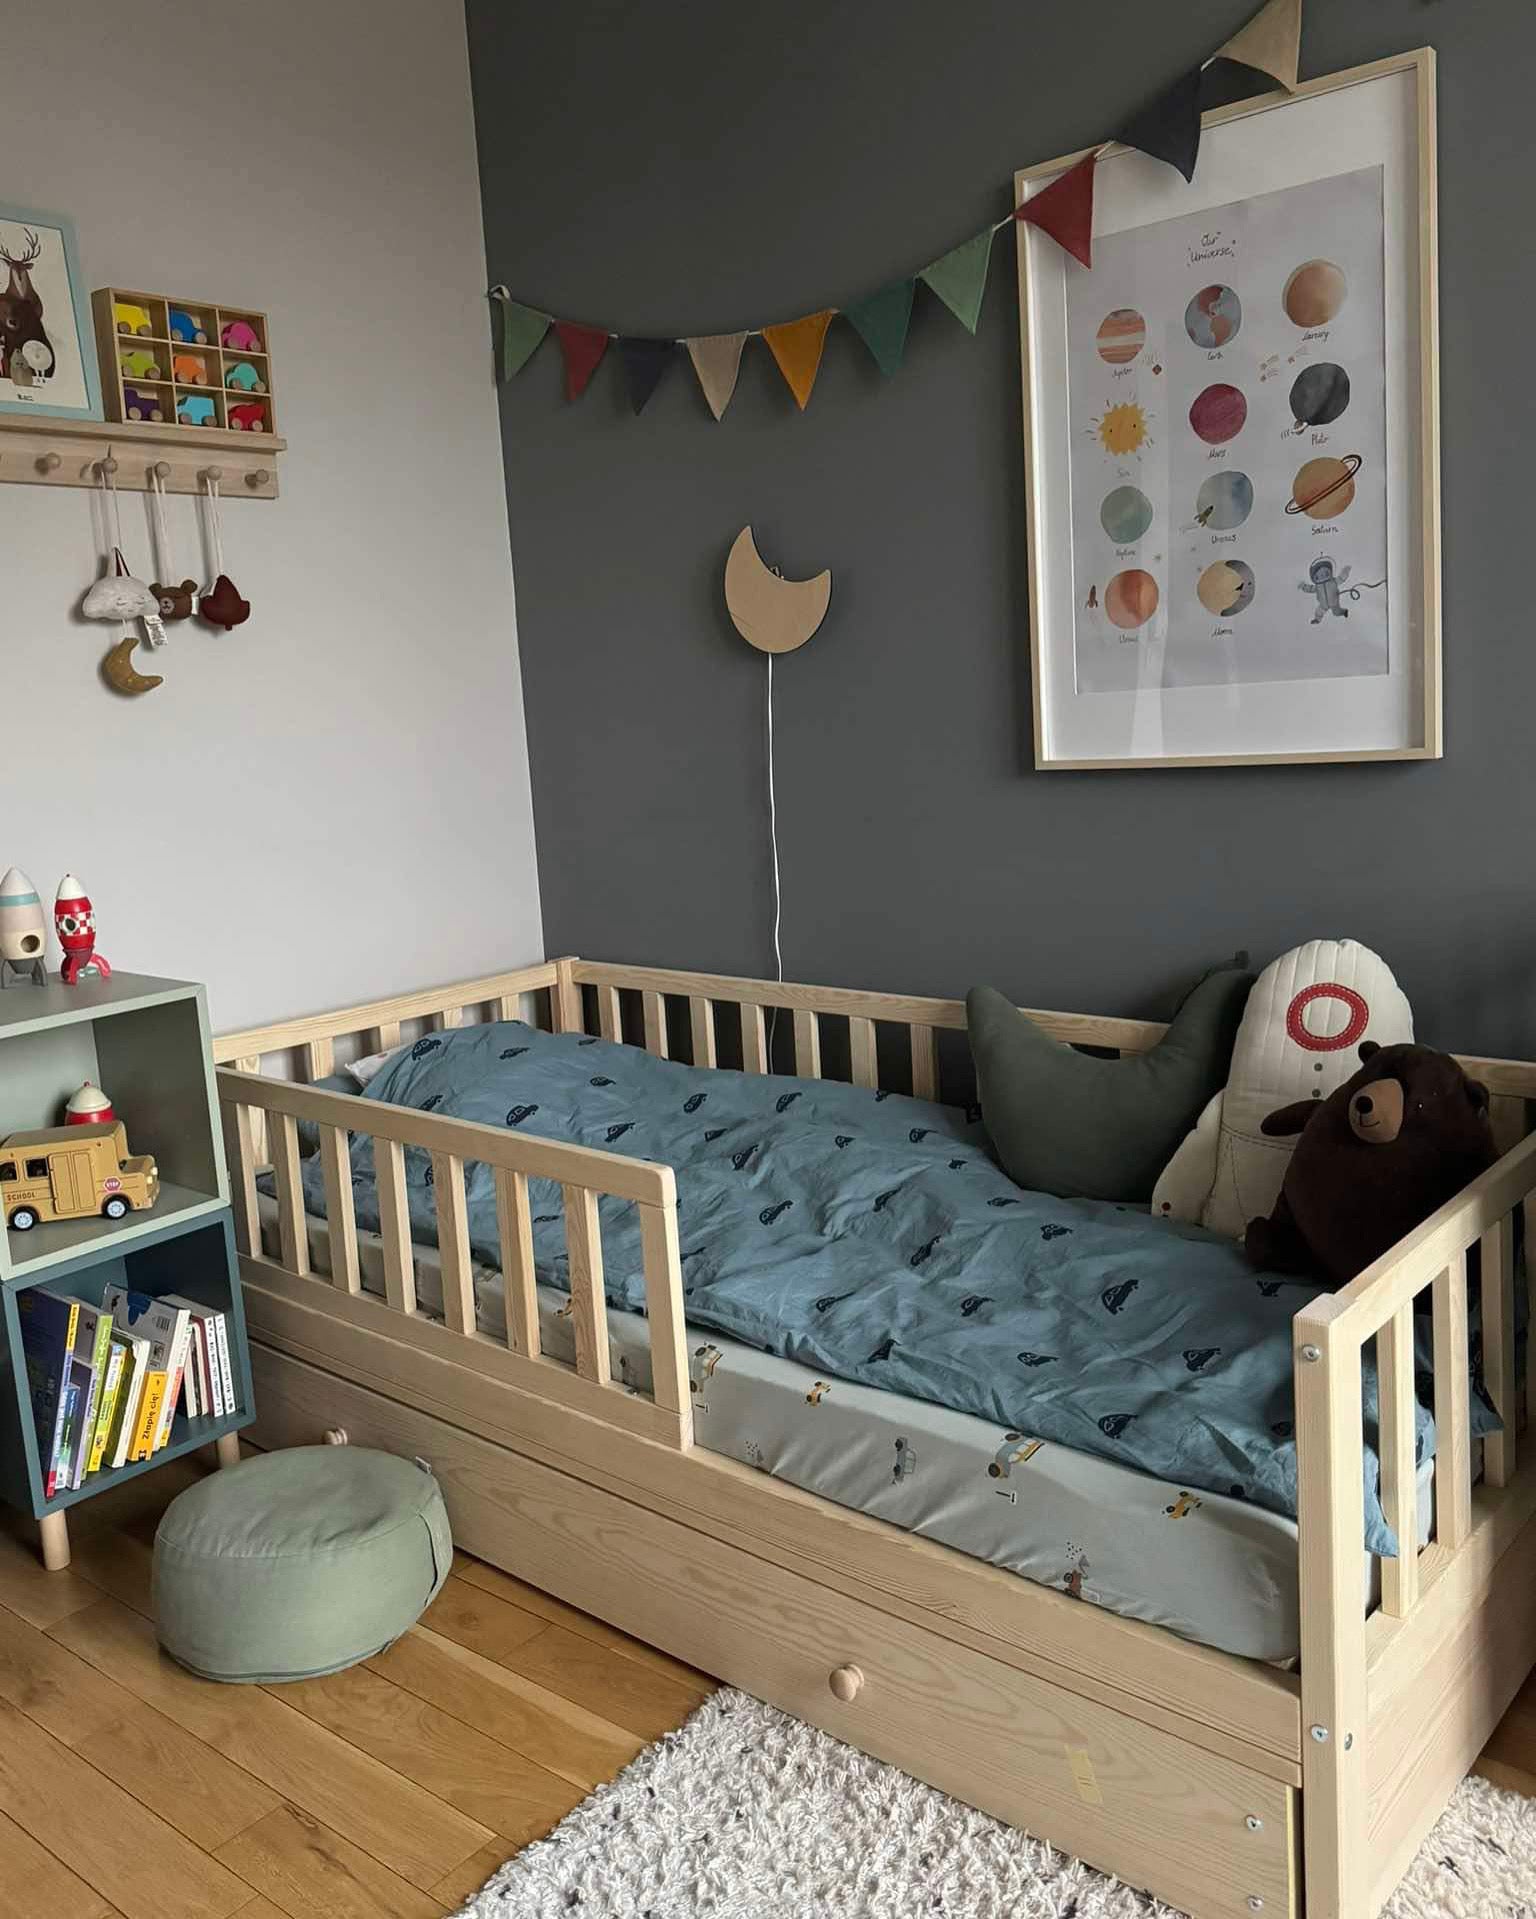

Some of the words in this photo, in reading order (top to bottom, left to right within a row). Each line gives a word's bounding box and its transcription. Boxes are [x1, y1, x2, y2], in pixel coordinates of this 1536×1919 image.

[1191, 247, 1233, 262] Universe
[7, 1190, 36, 1202] SCHOOL
[142, 1410, 156, 1440] Złapię
